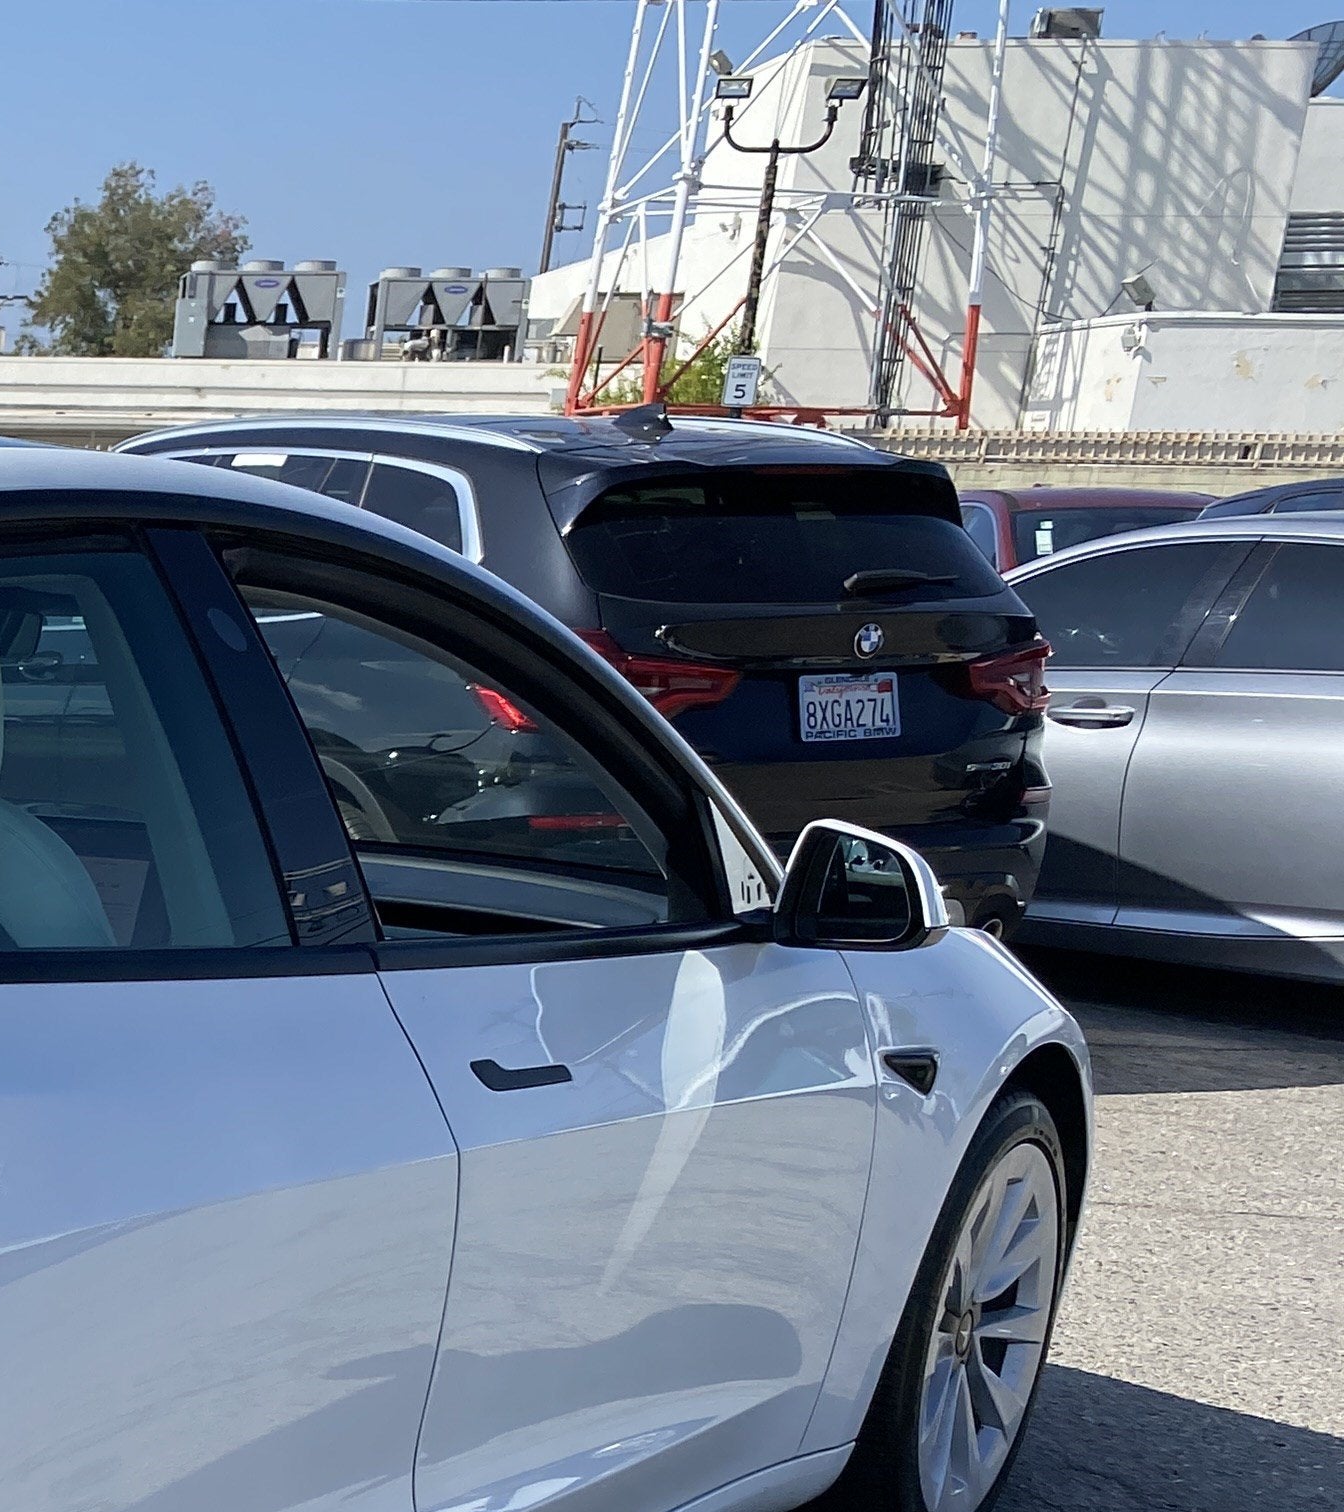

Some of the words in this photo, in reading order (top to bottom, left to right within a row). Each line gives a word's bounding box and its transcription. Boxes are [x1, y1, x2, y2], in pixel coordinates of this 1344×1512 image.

[731, 363, 758, 371] SPEED
[732, 371, 754, 379] LIMIT
[733, 383, 746, 399] 5
[806, 697, 890, 730] 8XGA274
[805, 728, 857, 740] PACIFIC
[863, 726, 897, 738] BMW
